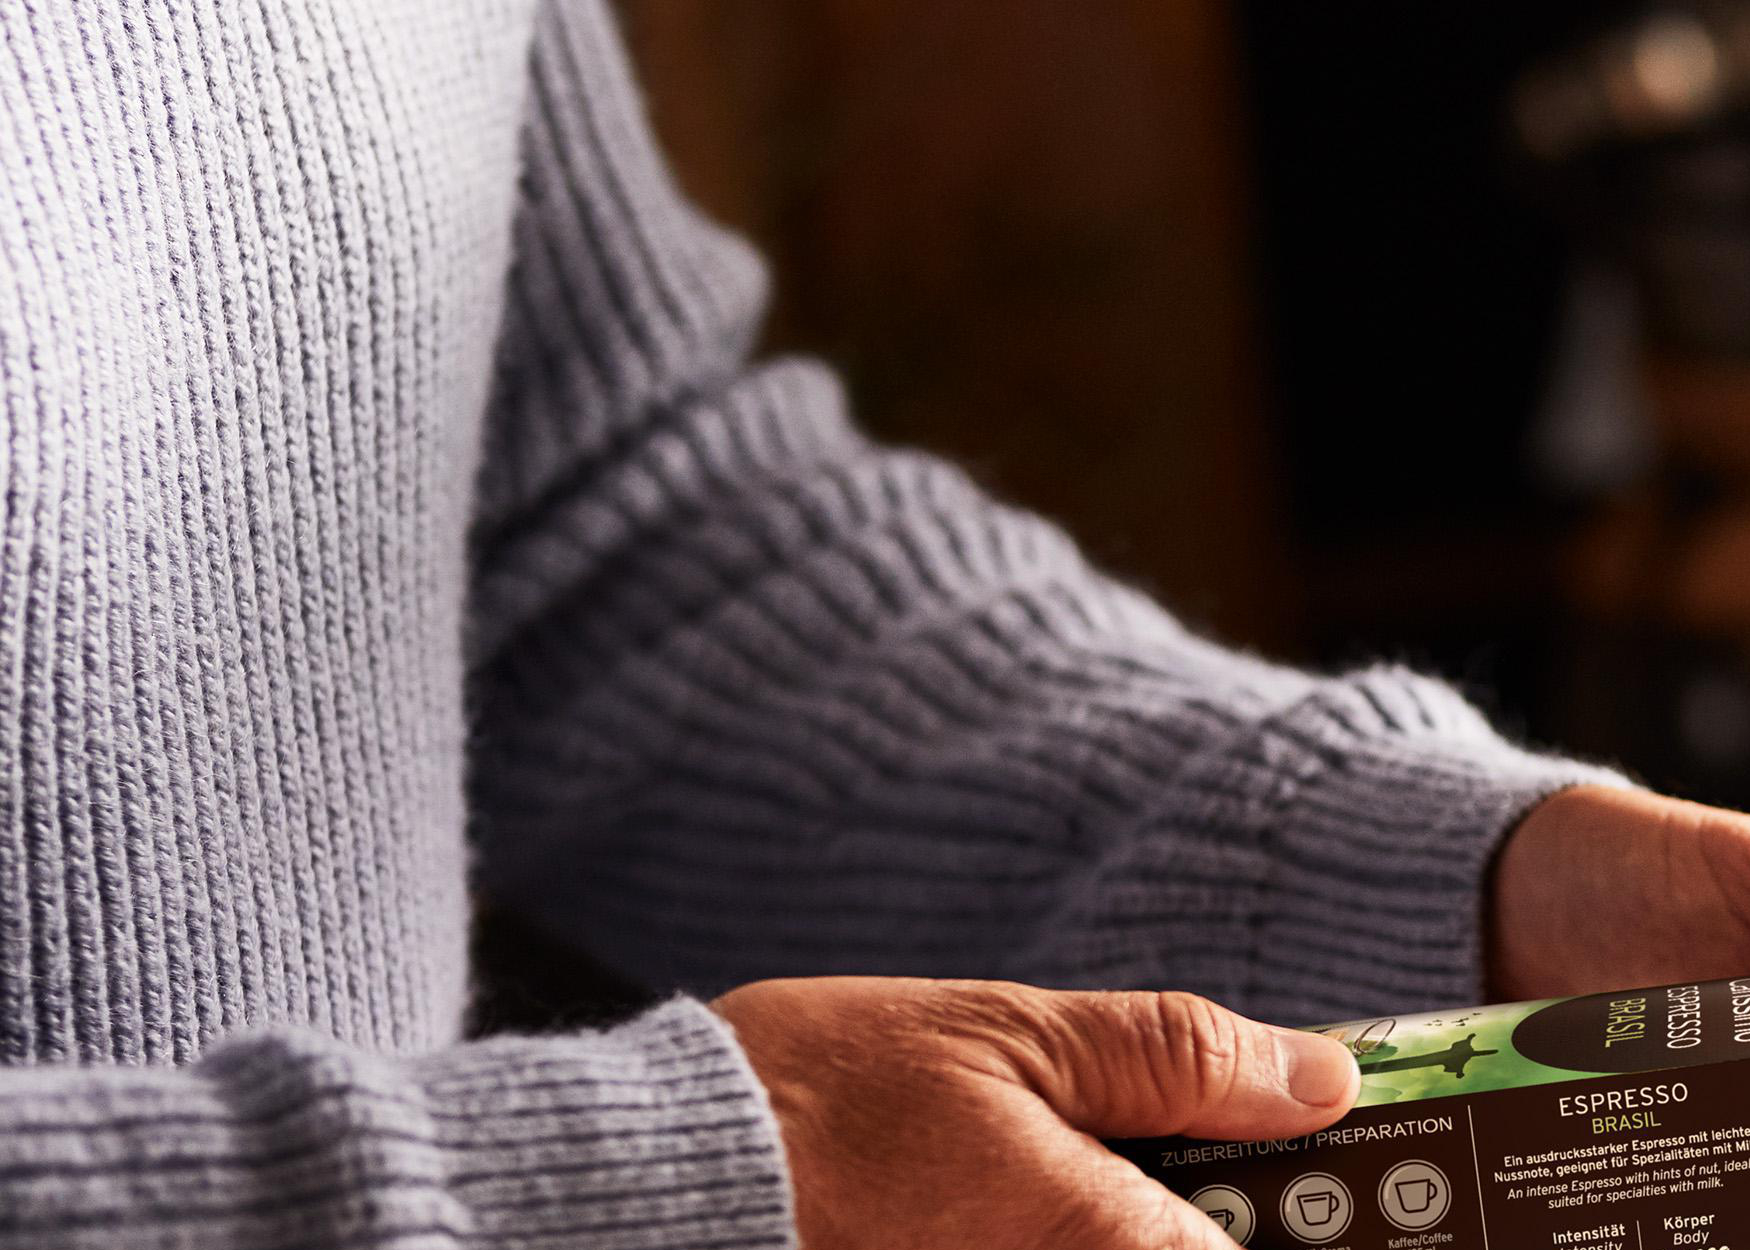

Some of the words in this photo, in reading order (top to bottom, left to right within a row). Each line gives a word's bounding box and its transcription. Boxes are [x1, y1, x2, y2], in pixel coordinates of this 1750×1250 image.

[1605, 998, 1646, 1048] BRASIL
[1666, 985, 1701, 1049] ESPRESSO
[1559, 1082, 1687, 1116] ESPRESSO
[1592, 1111, 1661, 1134] BRASIL
[1161, 1136, 1298, 1167] ZUBEREITUNG
[1316, 1116, 1453, 1148] PREPARATION
[1504, 1155, 1522, 1167] Ein
[1526, 1143, 1628, 1164] ausdrucksstarker
[1631, 1136, 1685, 1151] Espresso
[1688, 1131, 1708, 1143] mit
[1494, 1166, 1553, 1182] Nussnote,
[1556, 1158, 1607, 1177] geeignet
[1611, 1156, 1628, 1167] für
[1631, 1147, 1709, 1166] Spezialitäten
[1712, 1142, 1732, 1154] mit
[1507, 1188, 1523, 1199] An
[1526, 1183, 1568, 1196] intense
[1571, 1176, 1622, 1192] Espresso
[1625, 1171, 1649, 1184] with
[1652, 1167, 1681, 1180] hints
[1684, 1164, 1696, 1177] of
[1699, 1162, 1720, 1174] nut,
[1548, 1193, 1583, 1208] suited
[1586, 1192, 1603, 1203] for
[1606, 1184, 1666, 1202] specialties
[1669, 1180, 1693, 1192] with
[1697, 1176, 1723, 1189] milk.
[1553, 1223, 1625, 1244] Intensität
[1663, 1214, 1714, 1229] Körper
[1673, 1229, 1709, 1245] Body
[1388, 1232, 1453, 1248] Kaffee/Coffee
